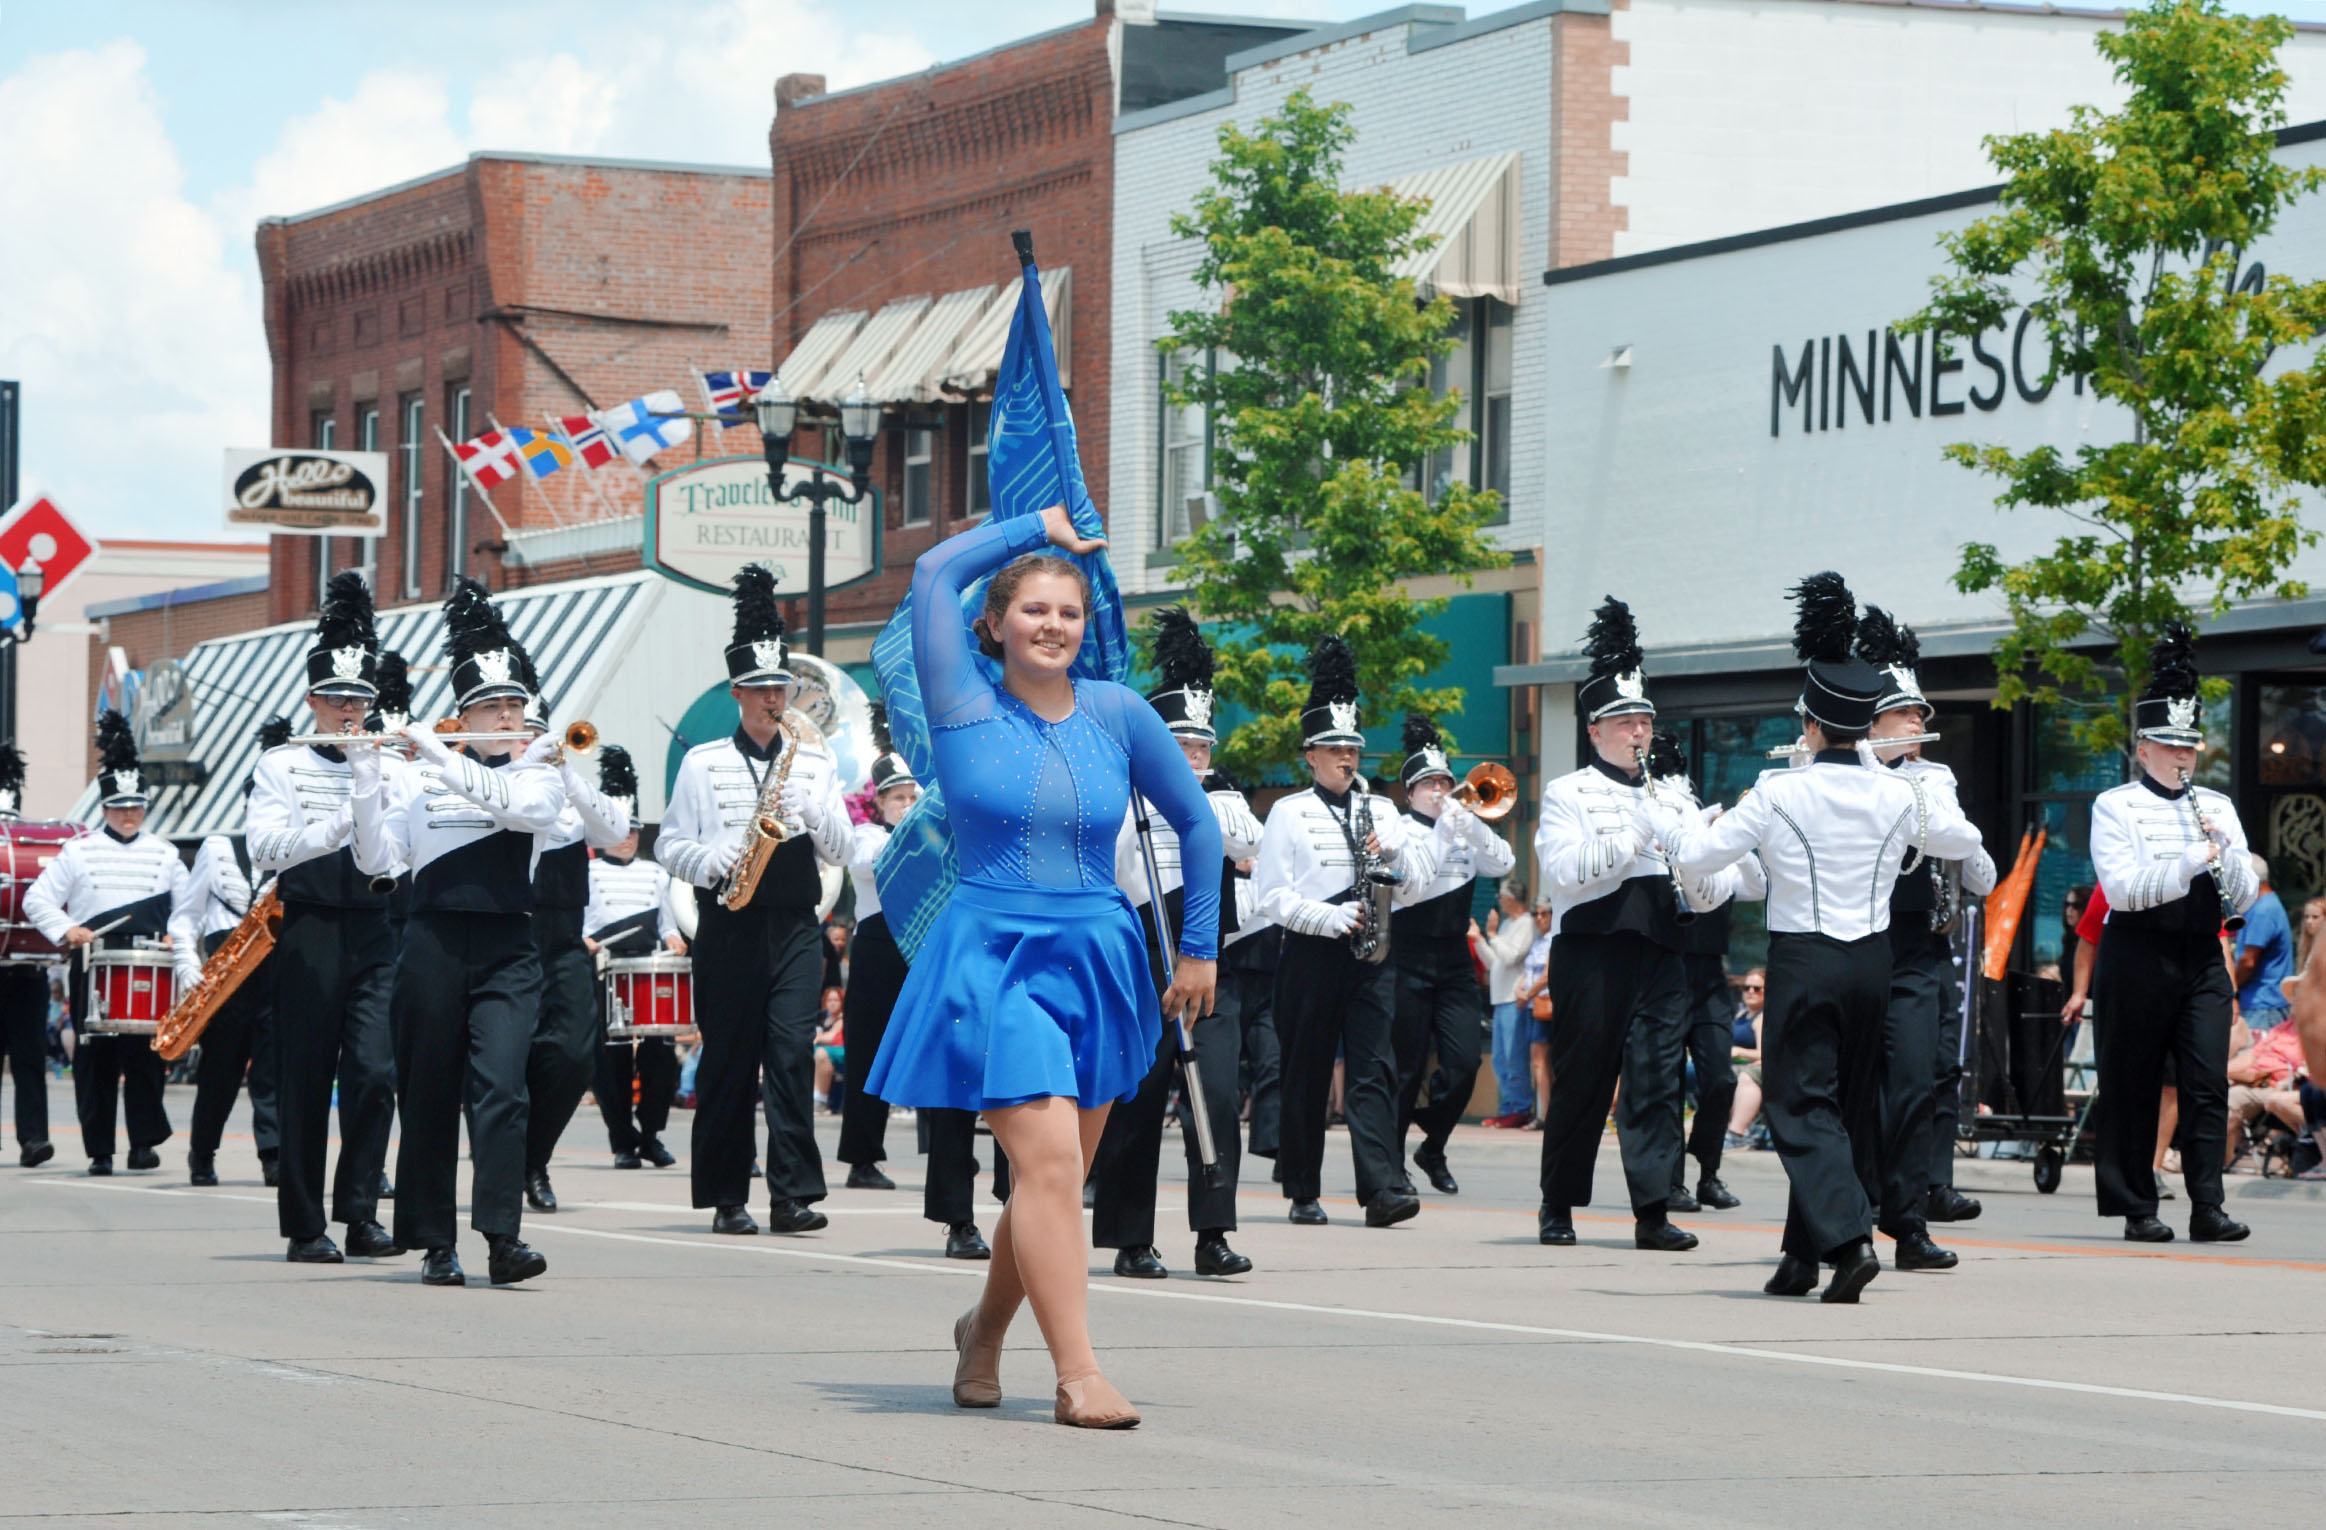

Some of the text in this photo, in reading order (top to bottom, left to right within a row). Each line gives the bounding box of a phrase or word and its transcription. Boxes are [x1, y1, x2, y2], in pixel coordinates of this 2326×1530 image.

[1770, 289, 2146, 438] MINNESOT
[241, 457, 352, 509] Hello
[281, 486, 368, 507] beautiful
[697, 524, 846, 550] RESTAURAT
